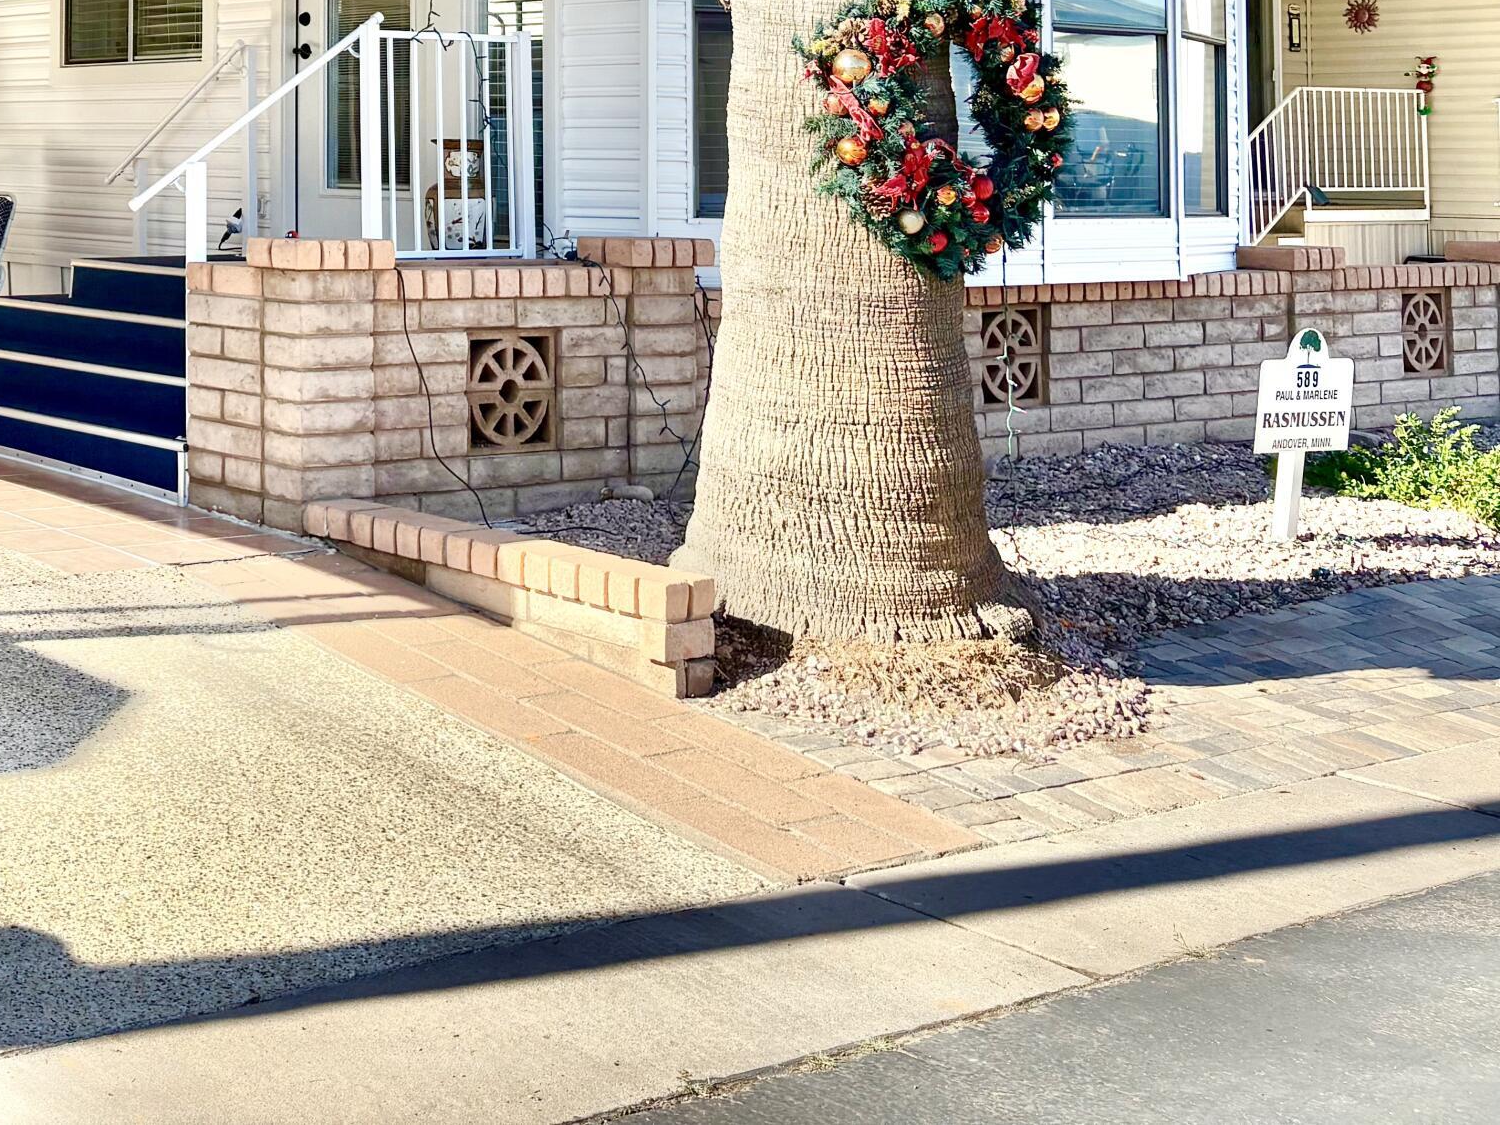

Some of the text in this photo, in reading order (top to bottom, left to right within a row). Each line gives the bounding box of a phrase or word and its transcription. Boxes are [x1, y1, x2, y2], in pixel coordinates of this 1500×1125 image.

[1296, 371, 1319, 388] 589
[1275, 389, 1338, 401] PAUL & MARLENE
[1262, 411, 1346, 429] RASMUSSEN
[1272, 437, 1332, 450] ANDOVER, MINN.
